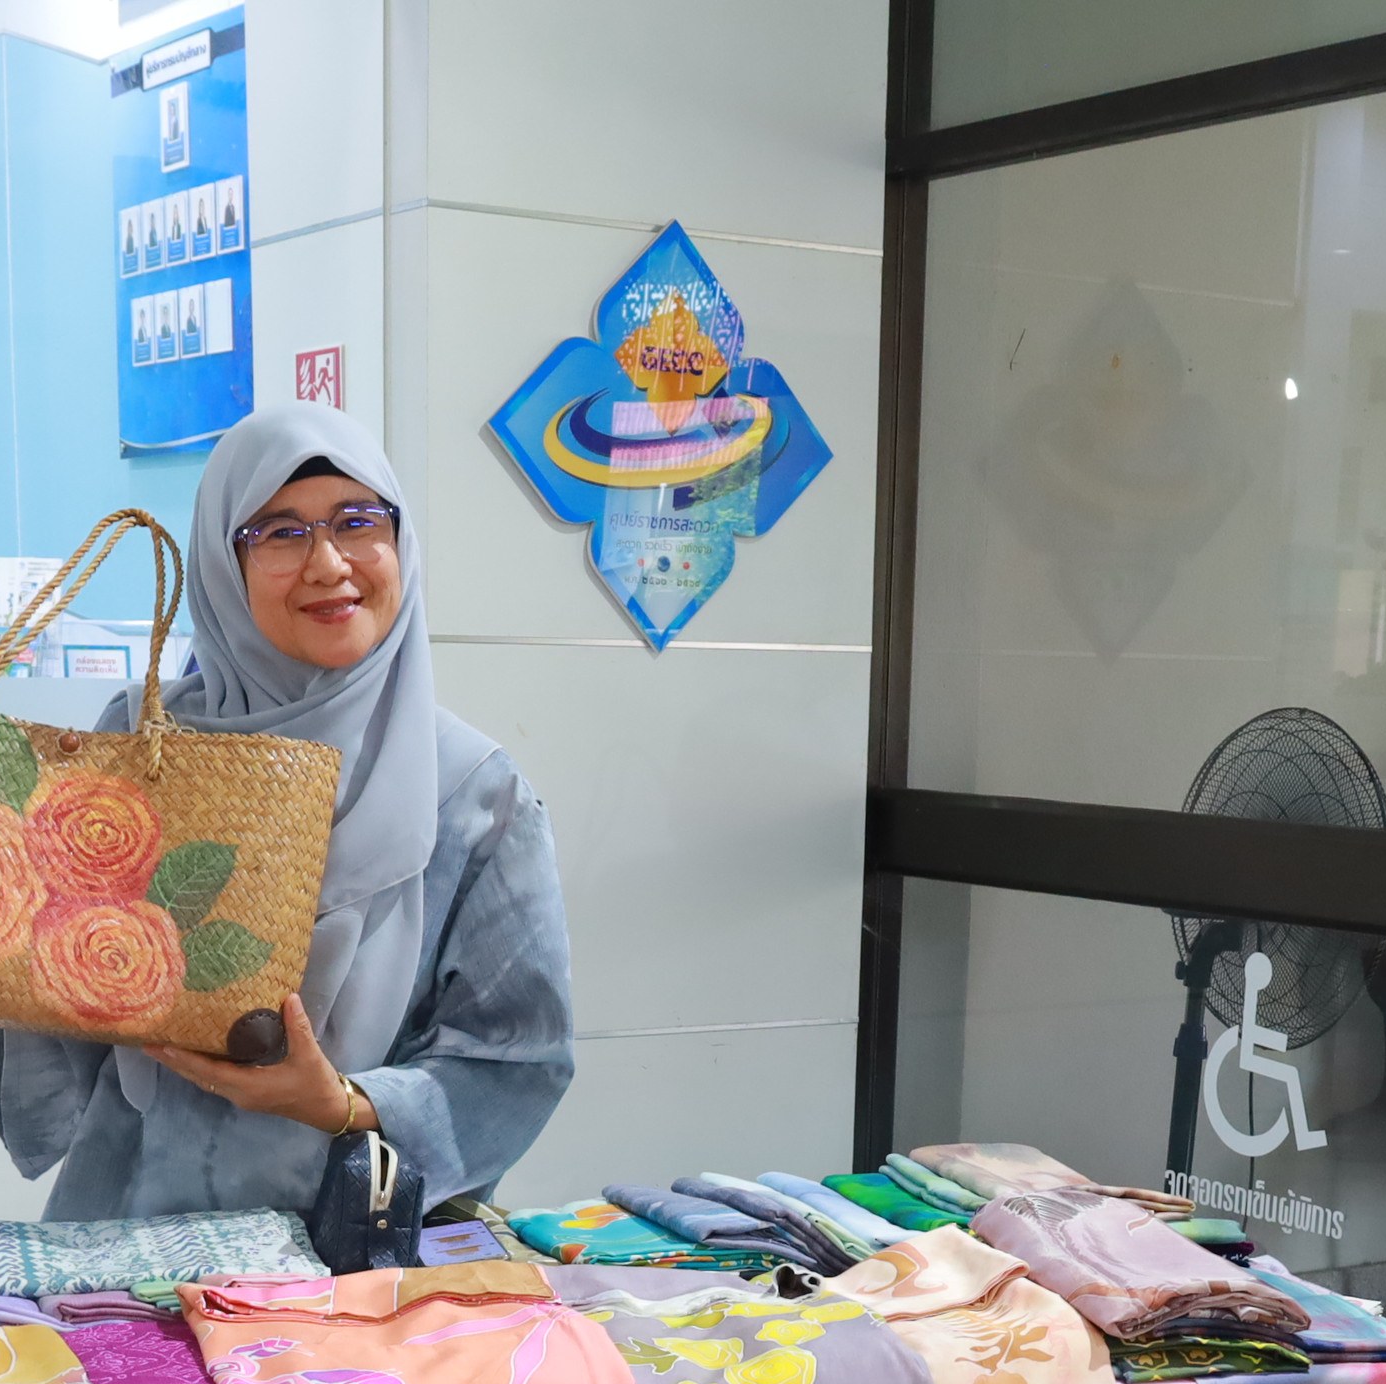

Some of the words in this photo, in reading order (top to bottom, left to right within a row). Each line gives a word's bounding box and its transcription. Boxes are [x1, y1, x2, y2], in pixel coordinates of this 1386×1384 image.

[641, 346, 704, 376] GECC
[609, 510, 720, 534] ศูนย์ราชการสะดวก
